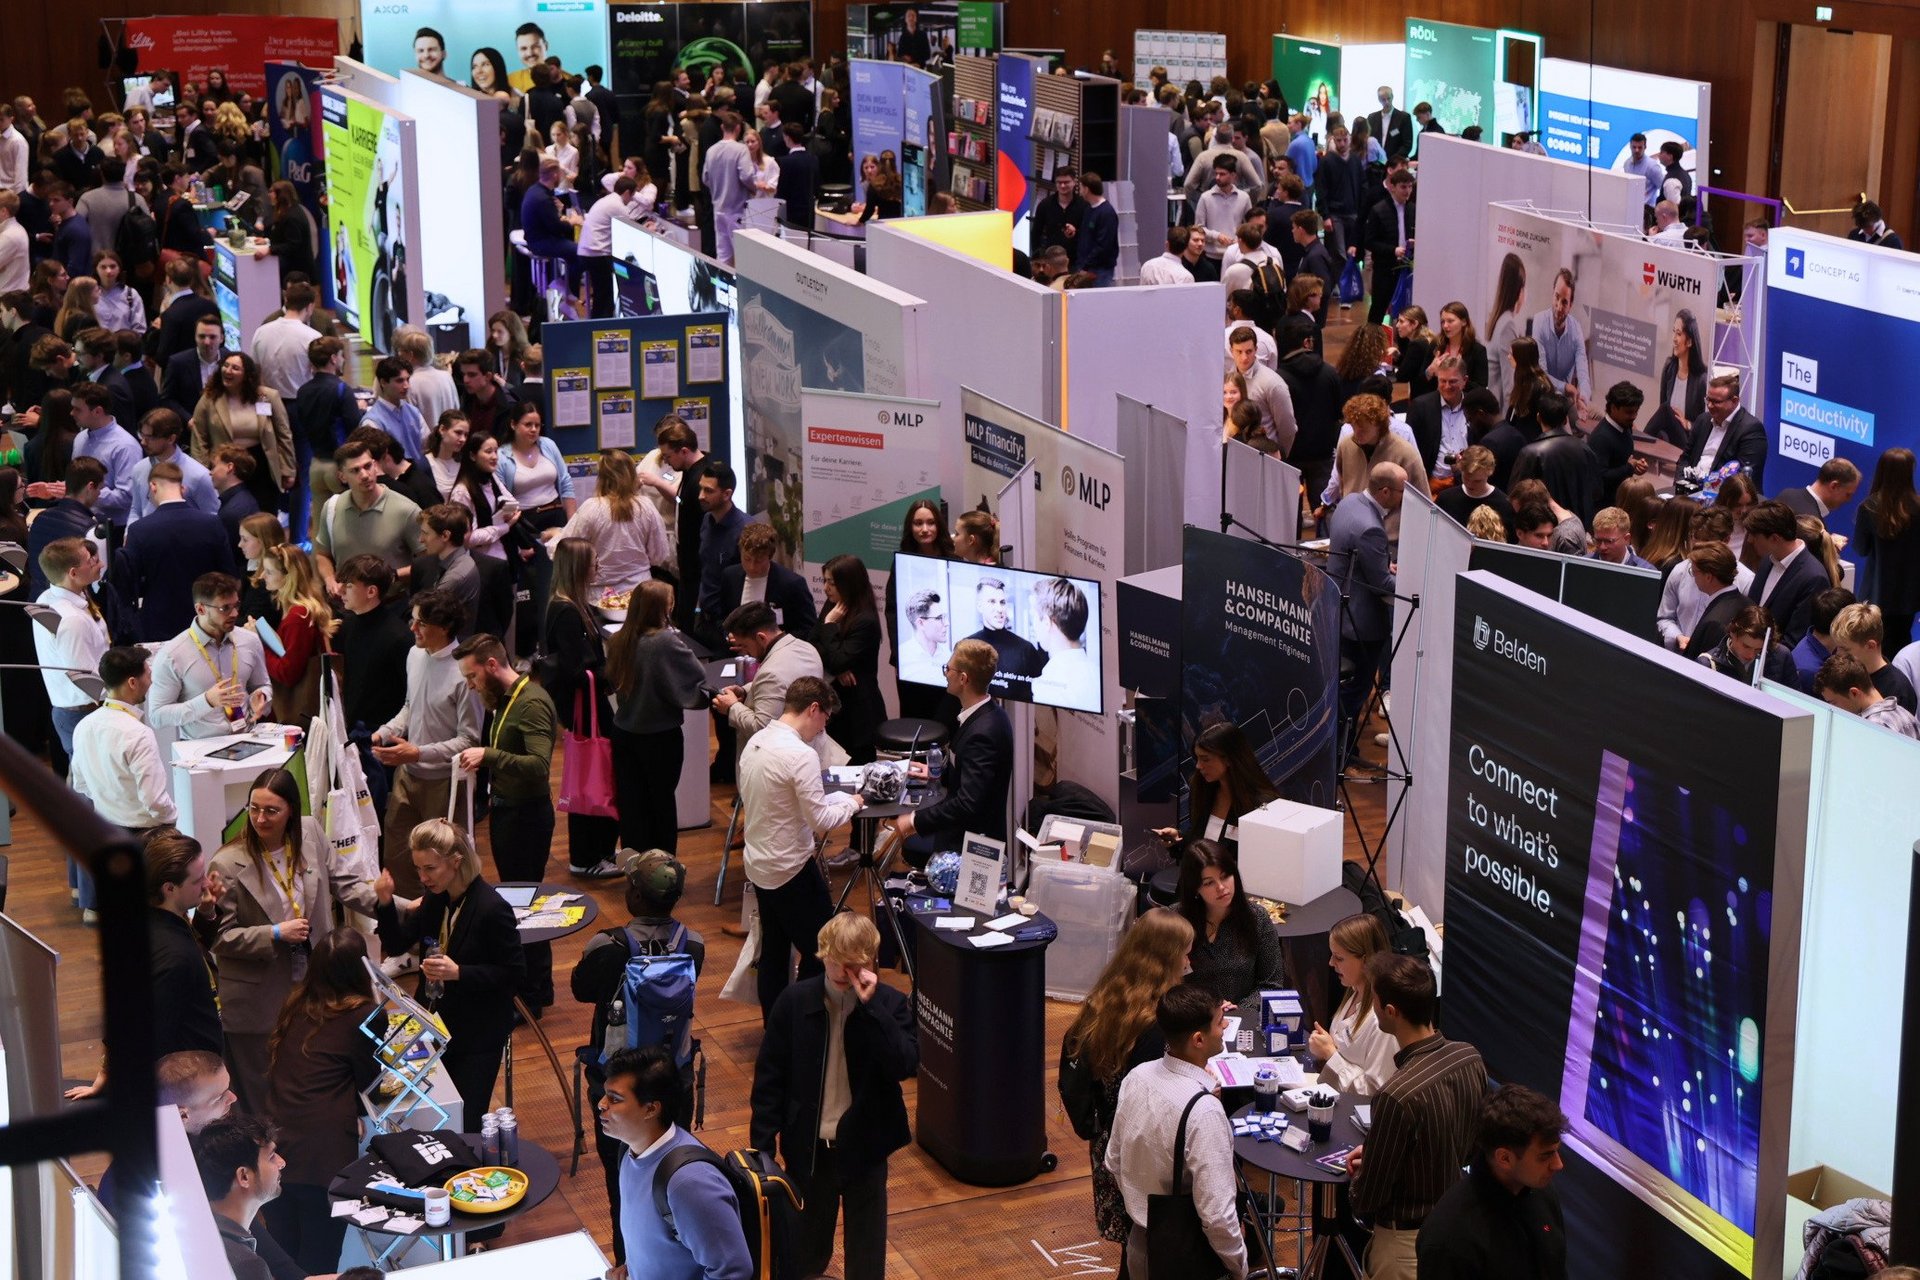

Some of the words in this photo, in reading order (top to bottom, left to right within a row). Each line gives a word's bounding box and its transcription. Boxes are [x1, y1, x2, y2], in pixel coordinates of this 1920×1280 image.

[374, 5, 408, 14] AXOR
[616, 11, 664, 23] Deloitte.
[288, 159, 312, 183] P&G
[796, 272, 828, 295] OUTLETCITY
[1808, 262, 1847, 278] CONCEPT
[1848, 271, 1860, 282] AG
[1787, 360, 1812, 384] The
[894, 411, 924, 428] MLP
[1785, 399, 1869, 439] productivity
[810, 429, 881, 446] Expertenwissen
[967, 420, 984, 441] MLP
[985, 425, 1024, 460] financify:
[1784, 434, 1830, 460] people
[811, 454, 820, 462] Für
[822, 456, 837, 464] deine
[1079, 472, 1111, 512] MLP
[1064, 528, 1077, 543] Volles
[1077, 536, 1099, 554] Programm
[1064, 541, 1083, 559] Finanzen
[1226, 579, 1312, 627] HANSELMANN
[1224, 598, 1311, 646] &COMPAGNIE
[1129, 630, 1170, 650] HANSELMANN
[1129, 638, 1170, 658] &COMPAGNIE
[1225, 620, 1277, 648] Management
[1278, 639, 1311, 664] Engineers
[1493, 628, 1547, 676] Belden
[1003, 671, 1017, 680] aktiv
[1468, 743, 1559, 819] Connect
[1467, 792, 1488, 828] to
[1493, 810, 1559, 869] what's
[1464, 844, 1555, 918] possible.
